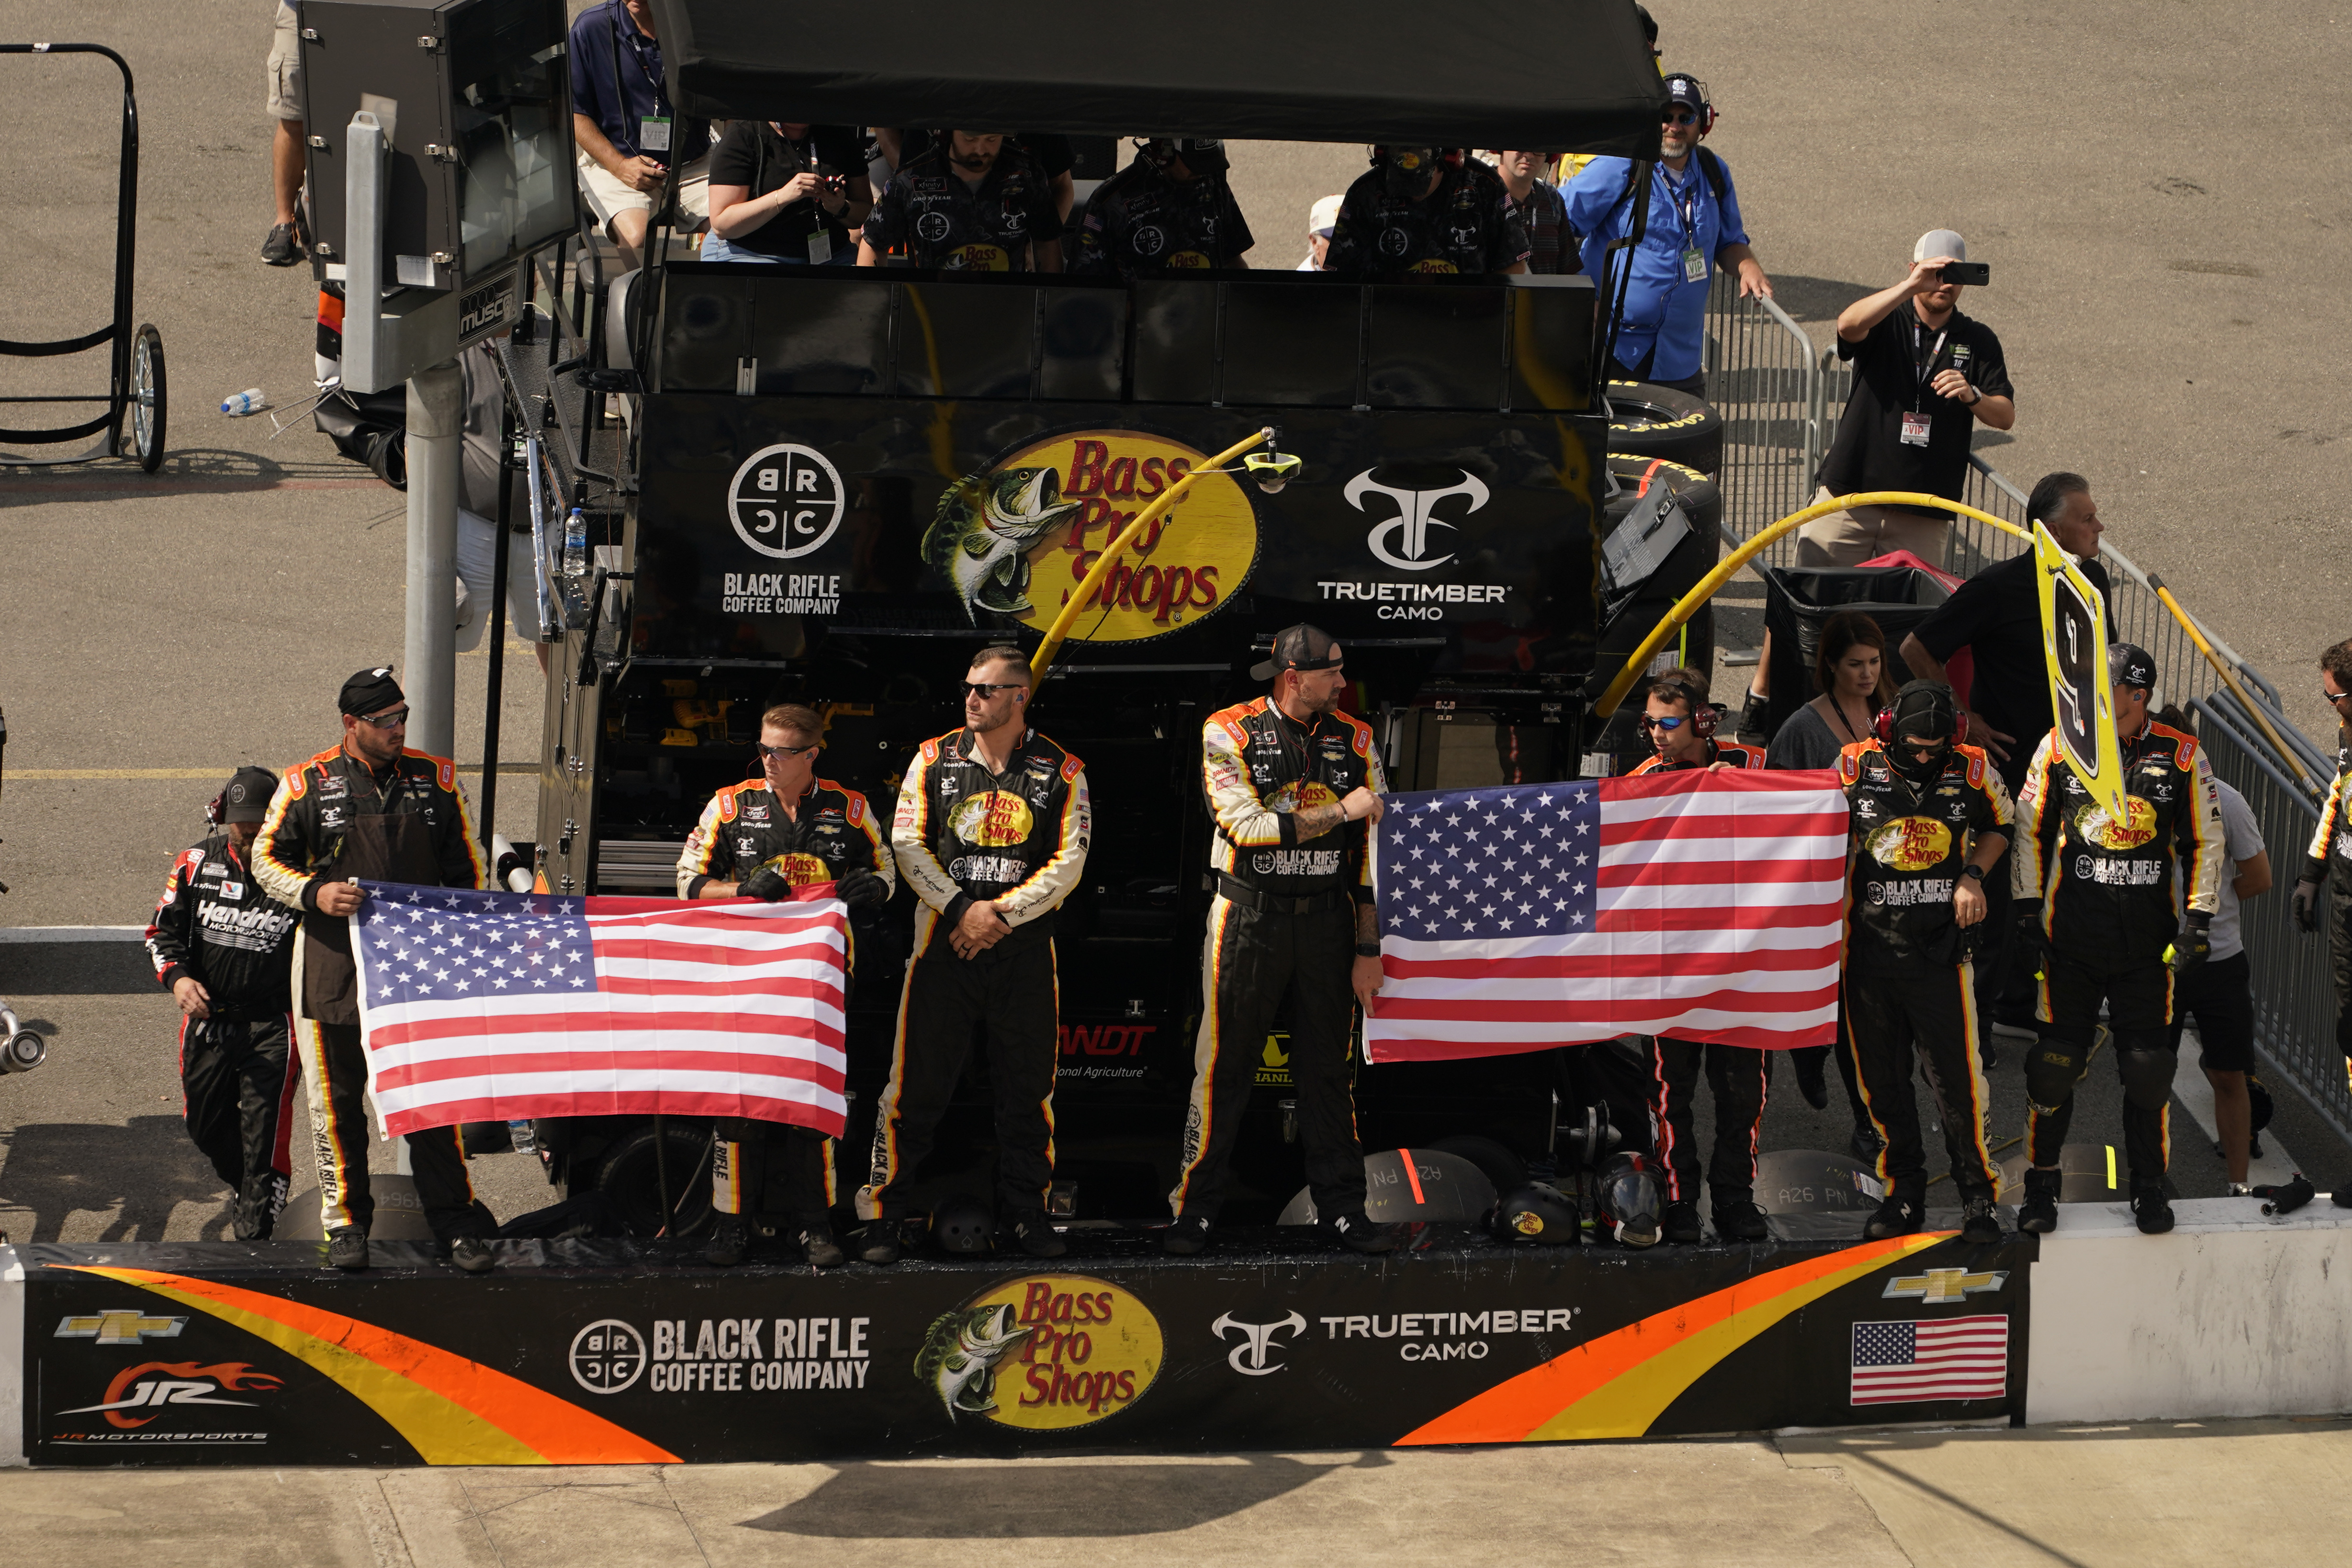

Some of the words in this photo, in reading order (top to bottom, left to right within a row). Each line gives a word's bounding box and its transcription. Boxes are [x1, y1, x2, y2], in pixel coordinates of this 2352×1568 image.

[918, 180, 941, 189] xfinity
[1130, 198, 1150, 210] xfinity
[965, 246, 997, 261] Bass
[1175, 253, 1199, 267] Bass
[1421, 261, 1449, 273] Bass
[1688, 261, 1703, 274] VIP
[1909, 425, 1924, 435] VIP
[1061, 440, 1191, 498] Bass
[1063, 497, 1161, 551] Pro
[724, 573, 783, 597] BLACK
[788, 575, 841, 598] RIFLE
[1060, 550, 1219, 622] Shops
[1317, 581, 1505, 603] TRUETIMBER
[722, 597, 772, 613] COFFEE
[775, 598, 840, 614] COMPANY
[1377, 605, 1443, 620] CAMO
[2182, 743, 2192, 762] SIMPSON
[1213, 767, 1237, 779] BRANDT
[1972, 759, 1981, 780] SIMPSON
[1862, 784, 1892, 792] GOODYEAR
[984, 793, 1021, 812] Bass
[985, 809, 1011, 825] Pro
[983, 823, 1023, 846] Shops
[1902, 819, 1937, 835] Bass
[1903, 832, 1929, 849] Pro
[966, 855, 1000, 871] BLACK
[1000, 857, 1027, 873] RIFLE
[1276, 850, 1312, 865] BLACK
[1313, 850, 1340, 865] RIFLE
[1902, 847, 1943, 864] Shops
[782, 856, 818, 873] Bass
[1276, 864, 1306, 875] COFFEE
[1306, 864, 1339, 875] COMPANY
[2095, 859, 2129, 875] BLACK
[2132, 860, 2161, 875] RIFLE
[785, 870, 810, 885] Pro
[966, 869, 993, 881] COFFEE
[2094, 873, 2126, 885] COFFEE
[2126, 872, 2161, 885] COMPANY
[1886, 880, 1922, 896] BLACK
[1923, 879, 1953, 893] RIFLE
[1887, 893, 1916, 906] COFFEE
[1917, 891, 1953, 904] COMPANY
[196, 899, 294, 934] Hendrick
[209, 922, 282, 942] MOTORSPORTS
[1058, 1025, 1157, 1056] ANDT
[1083, 1066, 1143, 1079] Agriculture
[316, 1132, 336, 1169] BLACK
[874, 1132, 889, 1171] BLACK
[1185, 1129, 1200, 1166] BLACK
[716, 1146, 728, 1181] RIFLE
[324, 1168, 337, 1205] RIFLE
[1372, 1168, 1398, 1188] PN
[1778, 1187, 1815, 1204] A26
[1824, 1187, 1848, 1206] PN
[1525, 1213, 1538, 1222] Bass
[1522, 1224, 1539, 1234] Shops
[1018, 1282, 1113, 1323] Bass
[1320, 1309, 1572, 1339] TRUETIMBER
[653, 1319, 764, 1361] BLACK
[775, 1317, 870, 1359] RIFLE
[1019, 1324, 1092, 1363] Pro
[1400, 1341, 1489, 1362] CAMO
[650, 1363, 743, 1392] COFFEE
[750, 1360, 870, 1390] COMPANY
[1019, 1363, 1136, 1413] Shops
